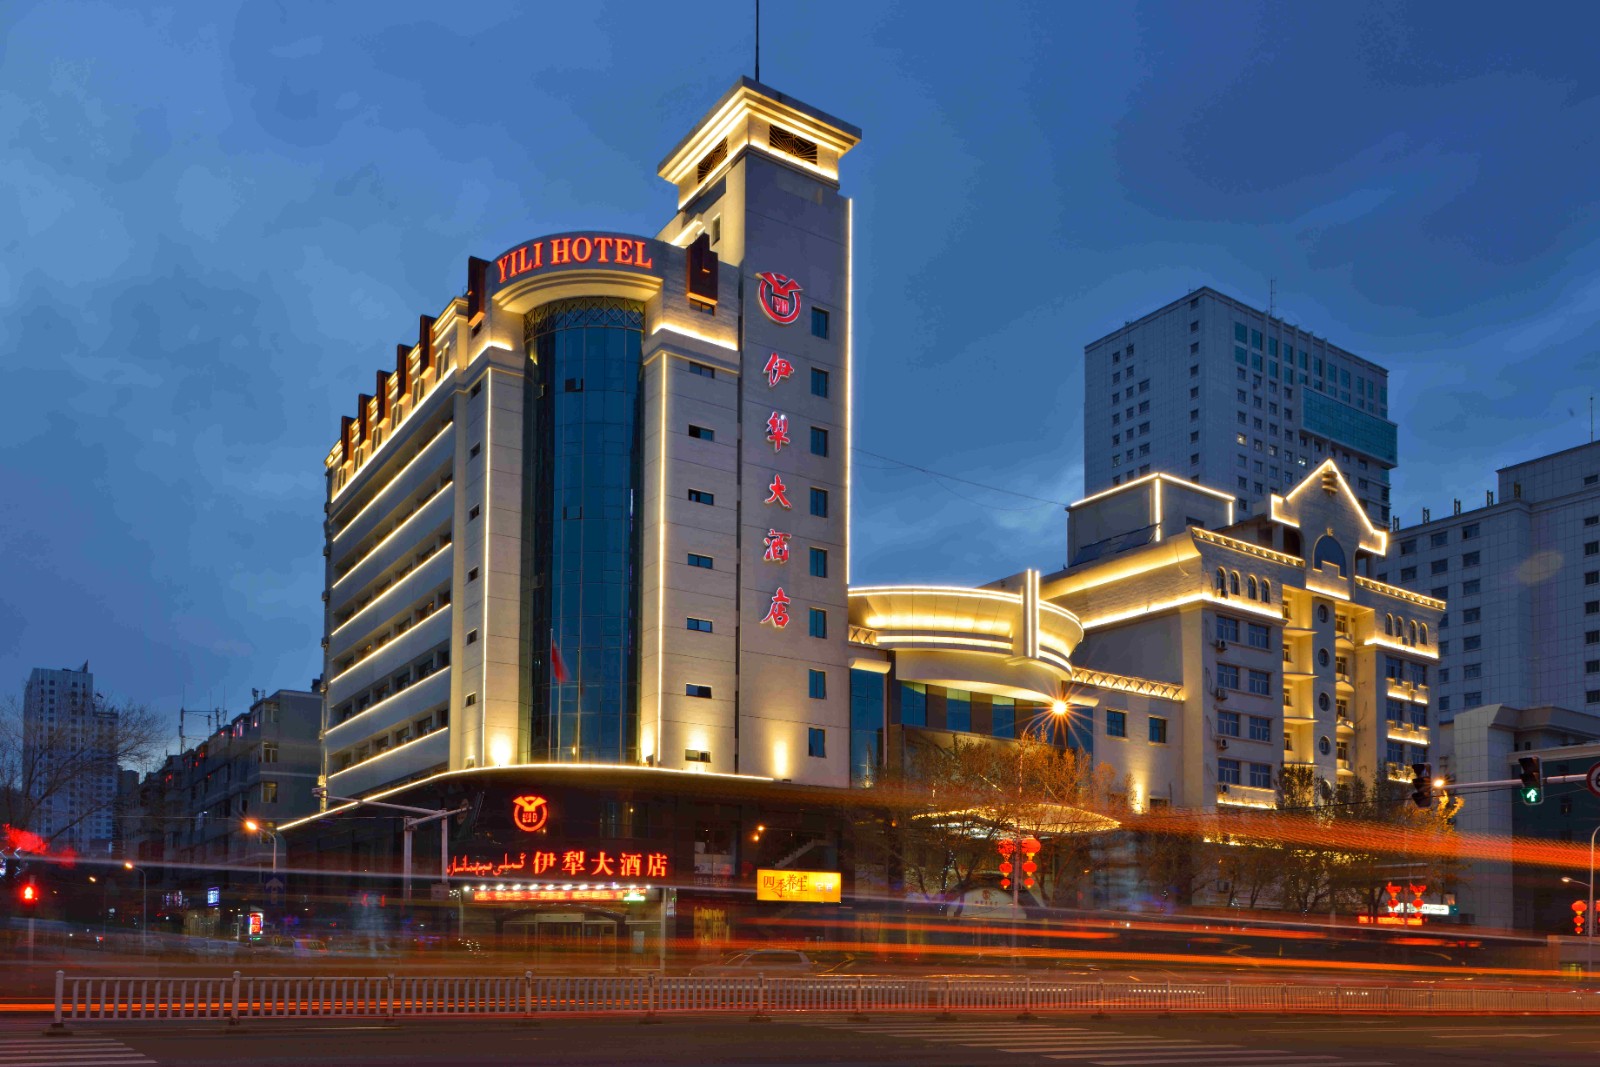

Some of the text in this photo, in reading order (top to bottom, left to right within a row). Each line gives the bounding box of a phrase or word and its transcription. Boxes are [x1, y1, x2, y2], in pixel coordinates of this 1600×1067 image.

[497, 237, 652, 283] YILI HOTEL
[760, 352, 795, 629] 伊犁大酒店
[533, 851, 669, 878] 伊犁大酒店
[763, 873, 808, 899] 四季养生
